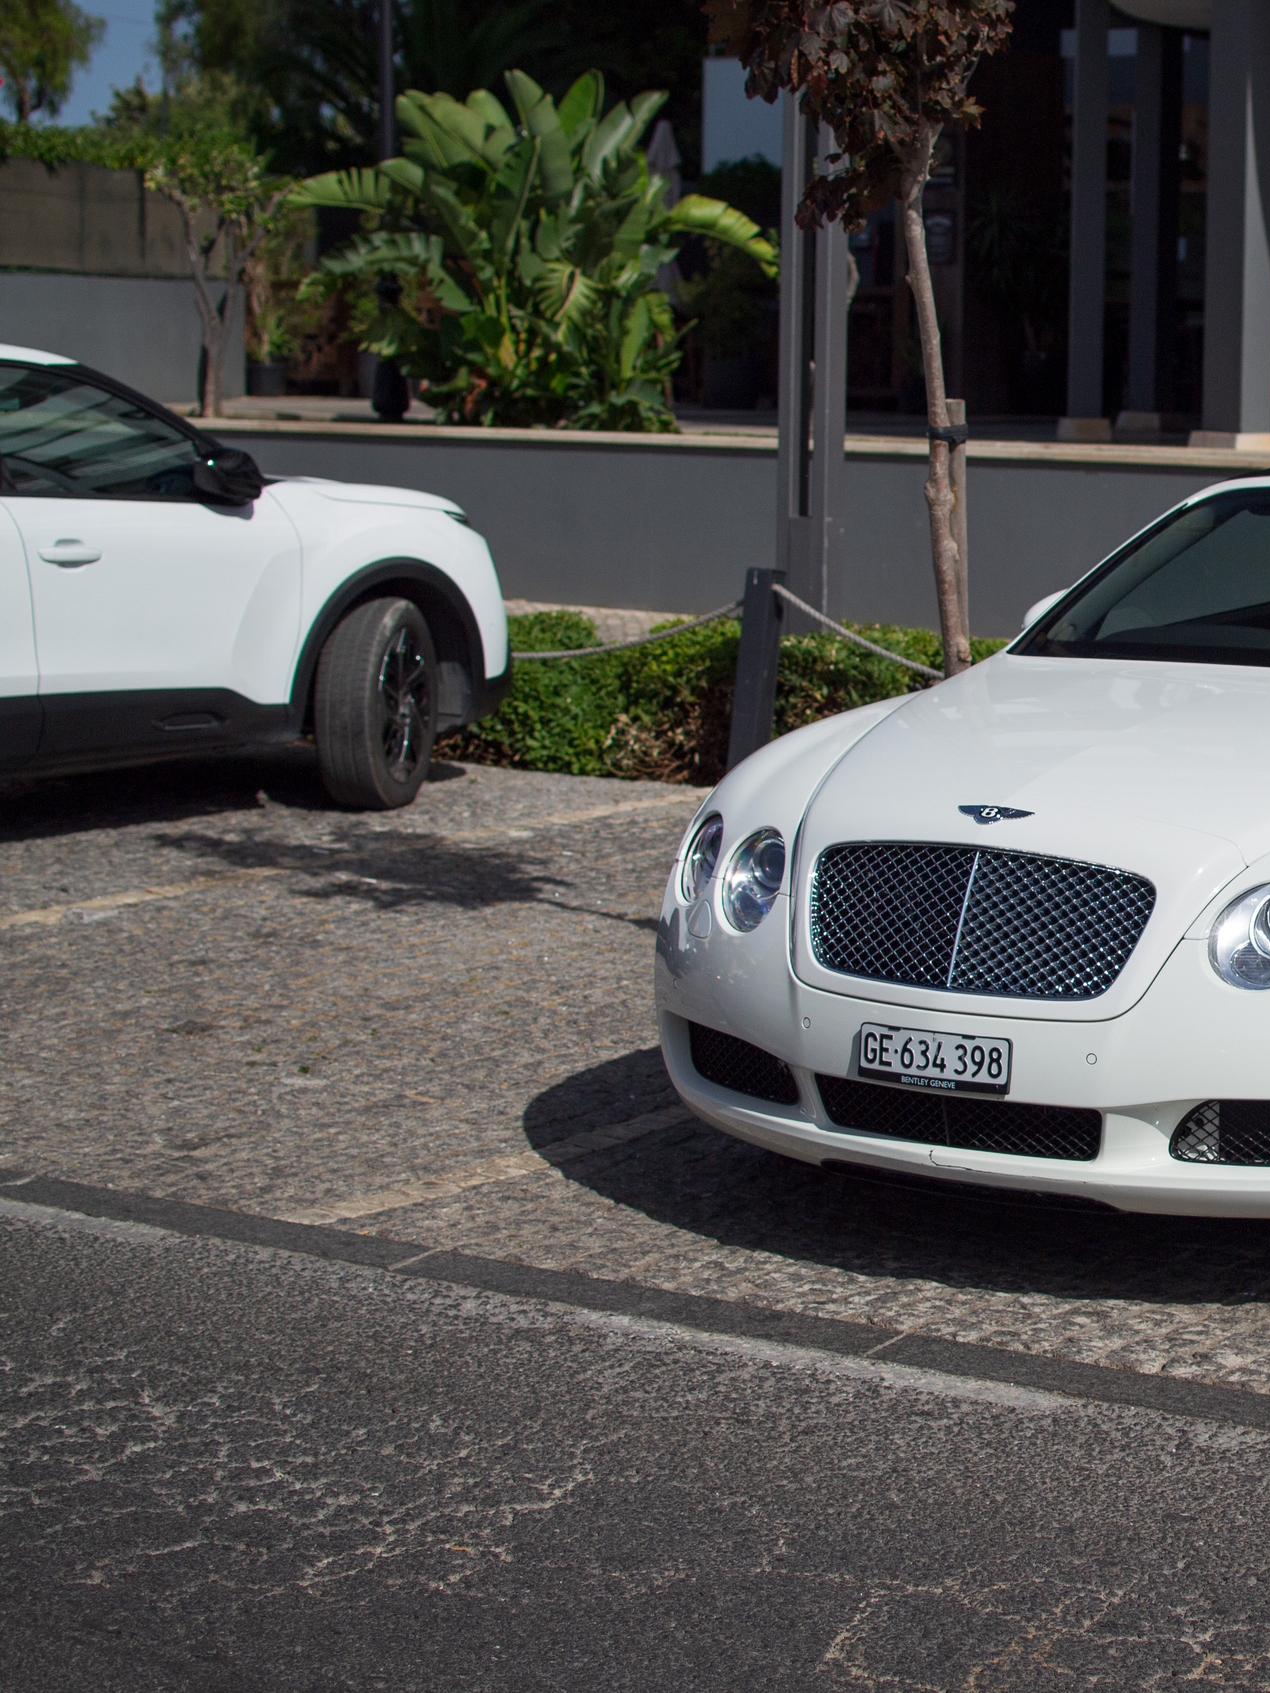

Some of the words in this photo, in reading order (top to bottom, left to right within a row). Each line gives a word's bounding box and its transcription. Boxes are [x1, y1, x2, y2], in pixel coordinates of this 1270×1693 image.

[953, 1043, 1003, 1079] 398
[901, 1075, 929, 1087] BENTLEY
[930, 1079, 956, 1089] GENEVE
